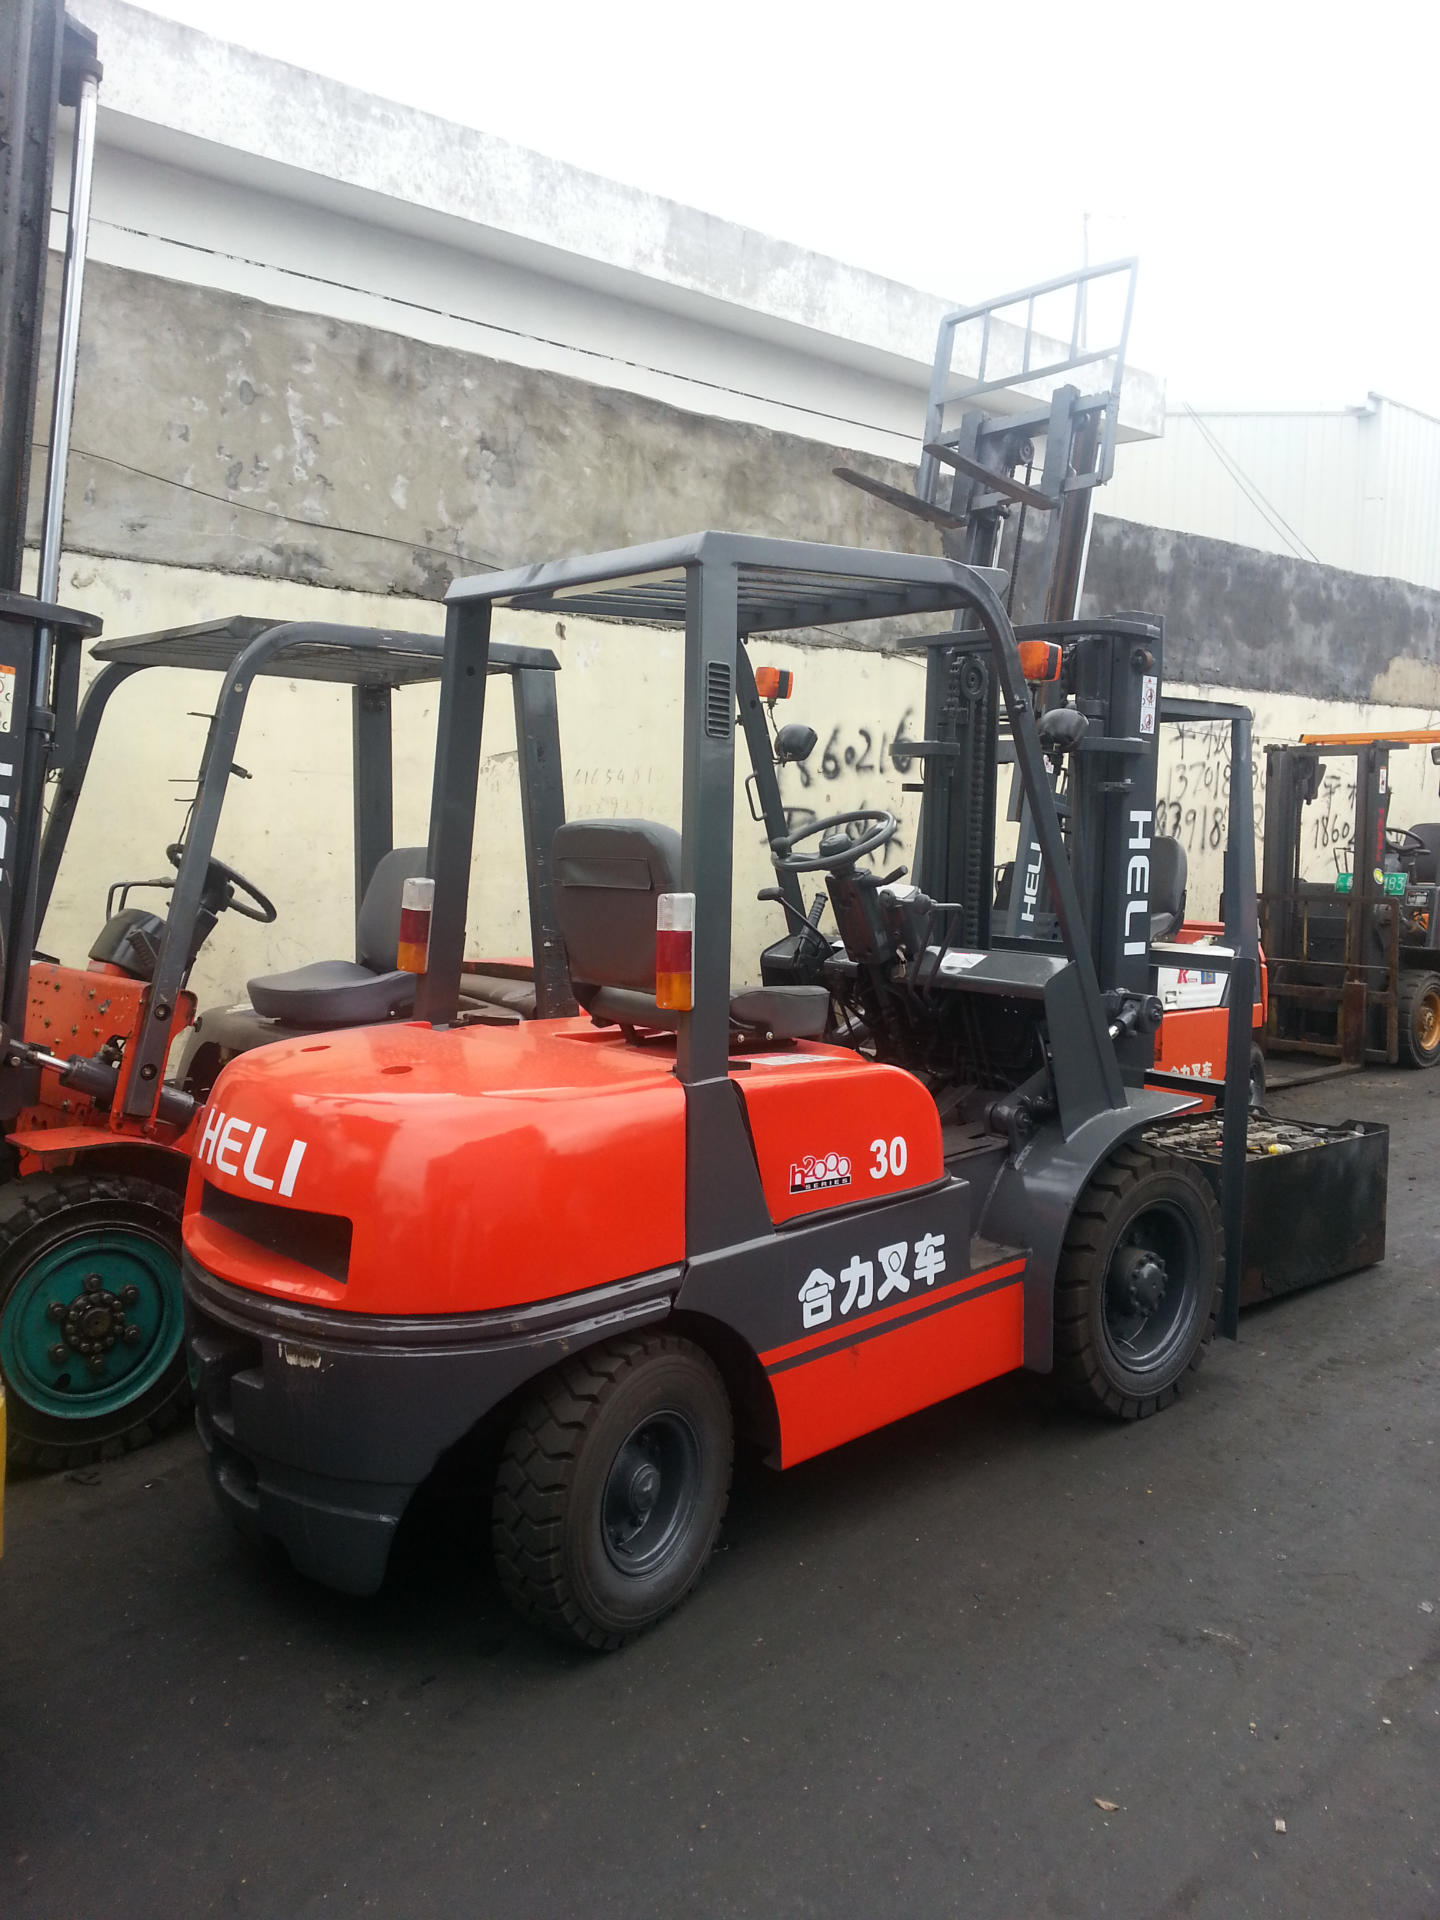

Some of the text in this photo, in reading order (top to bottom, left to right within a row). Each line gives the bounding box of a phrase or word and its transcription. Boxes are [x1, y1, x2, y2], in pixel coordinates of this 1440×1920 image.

[1124, 810, 1152, 956] HELI
[198, 1108, 307, 1198] HELI
[805, 1177, 848, 1190] SERIES
[869, 1136, 908, 1180] 30
[798, 1232, 947, 1329] 合力叉车
